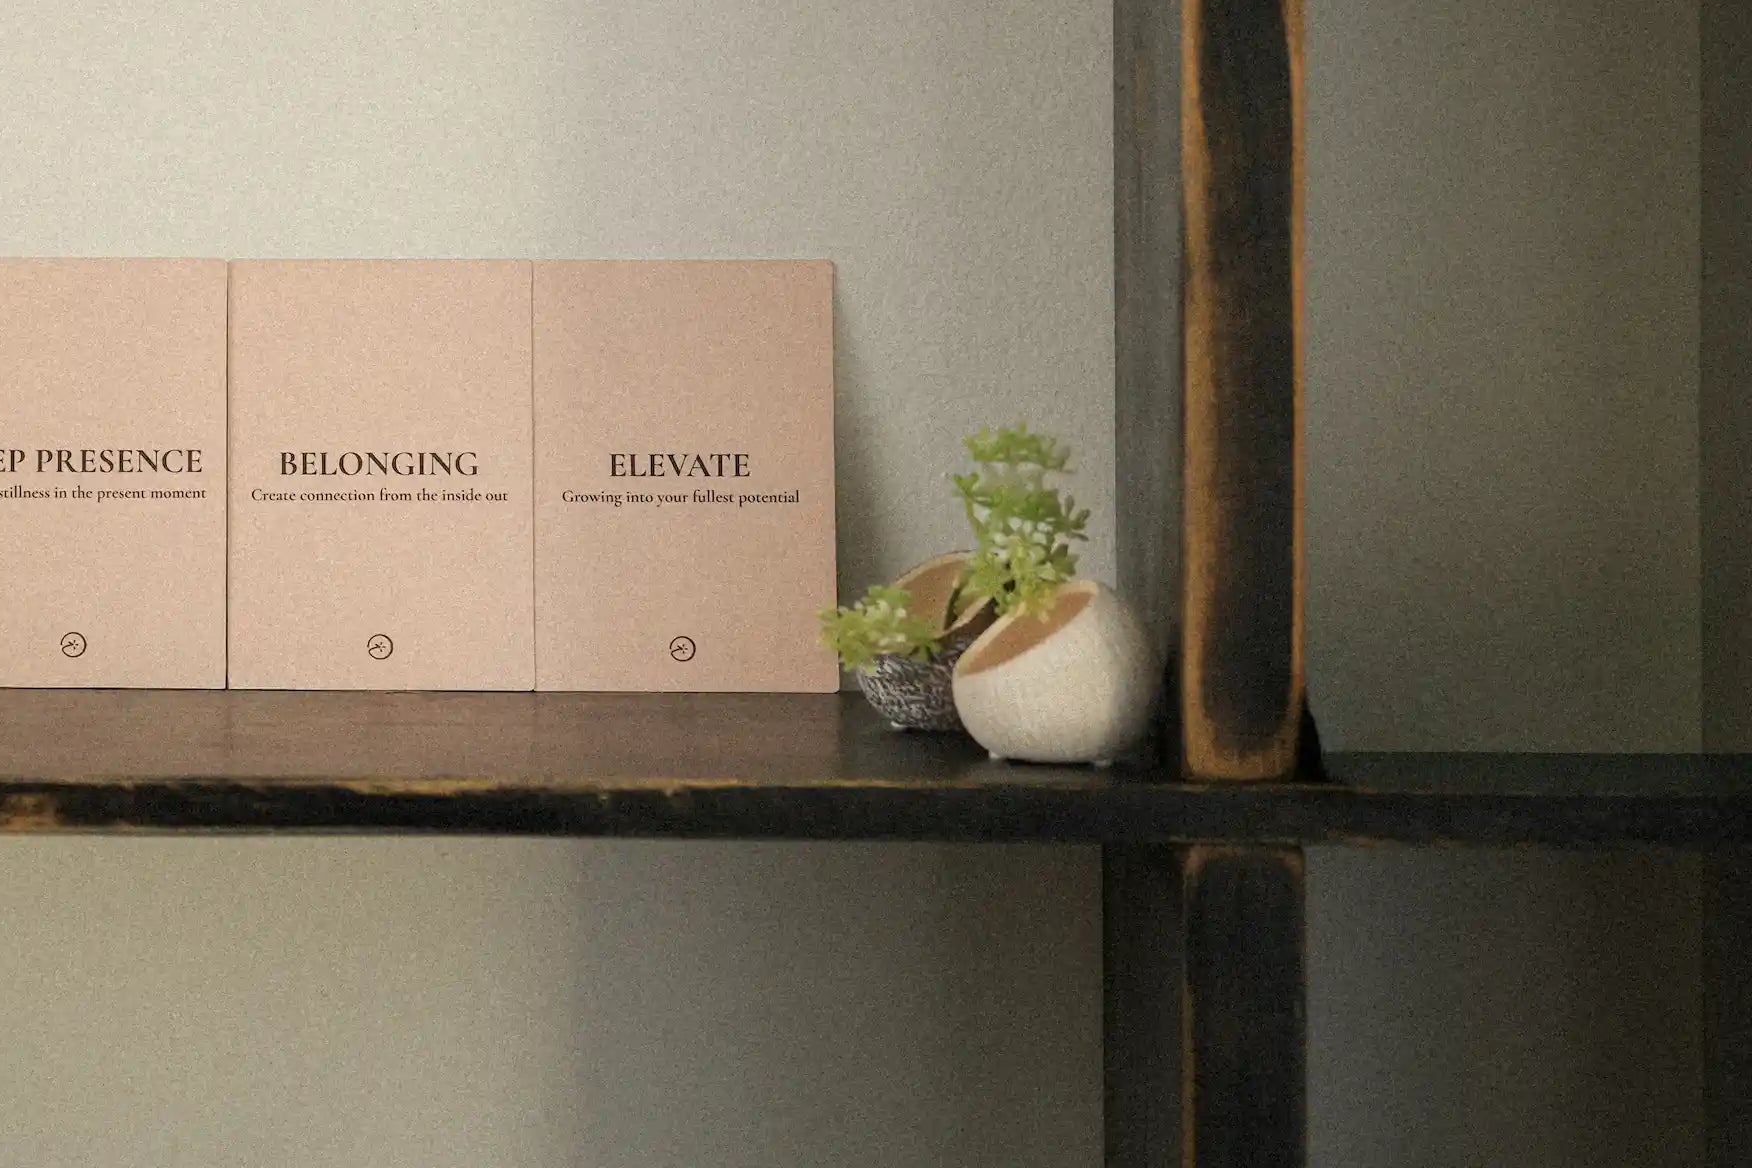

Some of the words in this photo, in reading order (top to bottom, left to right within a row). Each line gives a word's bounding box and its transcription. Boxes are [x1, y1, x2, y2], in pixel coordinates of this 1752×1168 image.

[35, 448, 203, 474] PRESENCE
[280, 451, 479, 477] BELONGING
[608, 452, 751, 478] ELEVATE
[53, 486, 67, 499] in
[71, 484, 93, 499] the
[96, 487, 147, 504] present
[150, 487, 207, 499] moment
[251, 487, 297, 502] Create
[299, 488, 376, 502] connection
[379, 487, 413, 502] from
[416, 487, 439, 502] the
[441, 487, 483, 502] inside
[485, 491, 509, 502] out
[561, 489, 623, 508] Growing
[625, 491, 654, 504] into
[656, 493, 689, 508] your
[692, 489, 735, 504] fullest
[738, 489, 800, 508] potential
